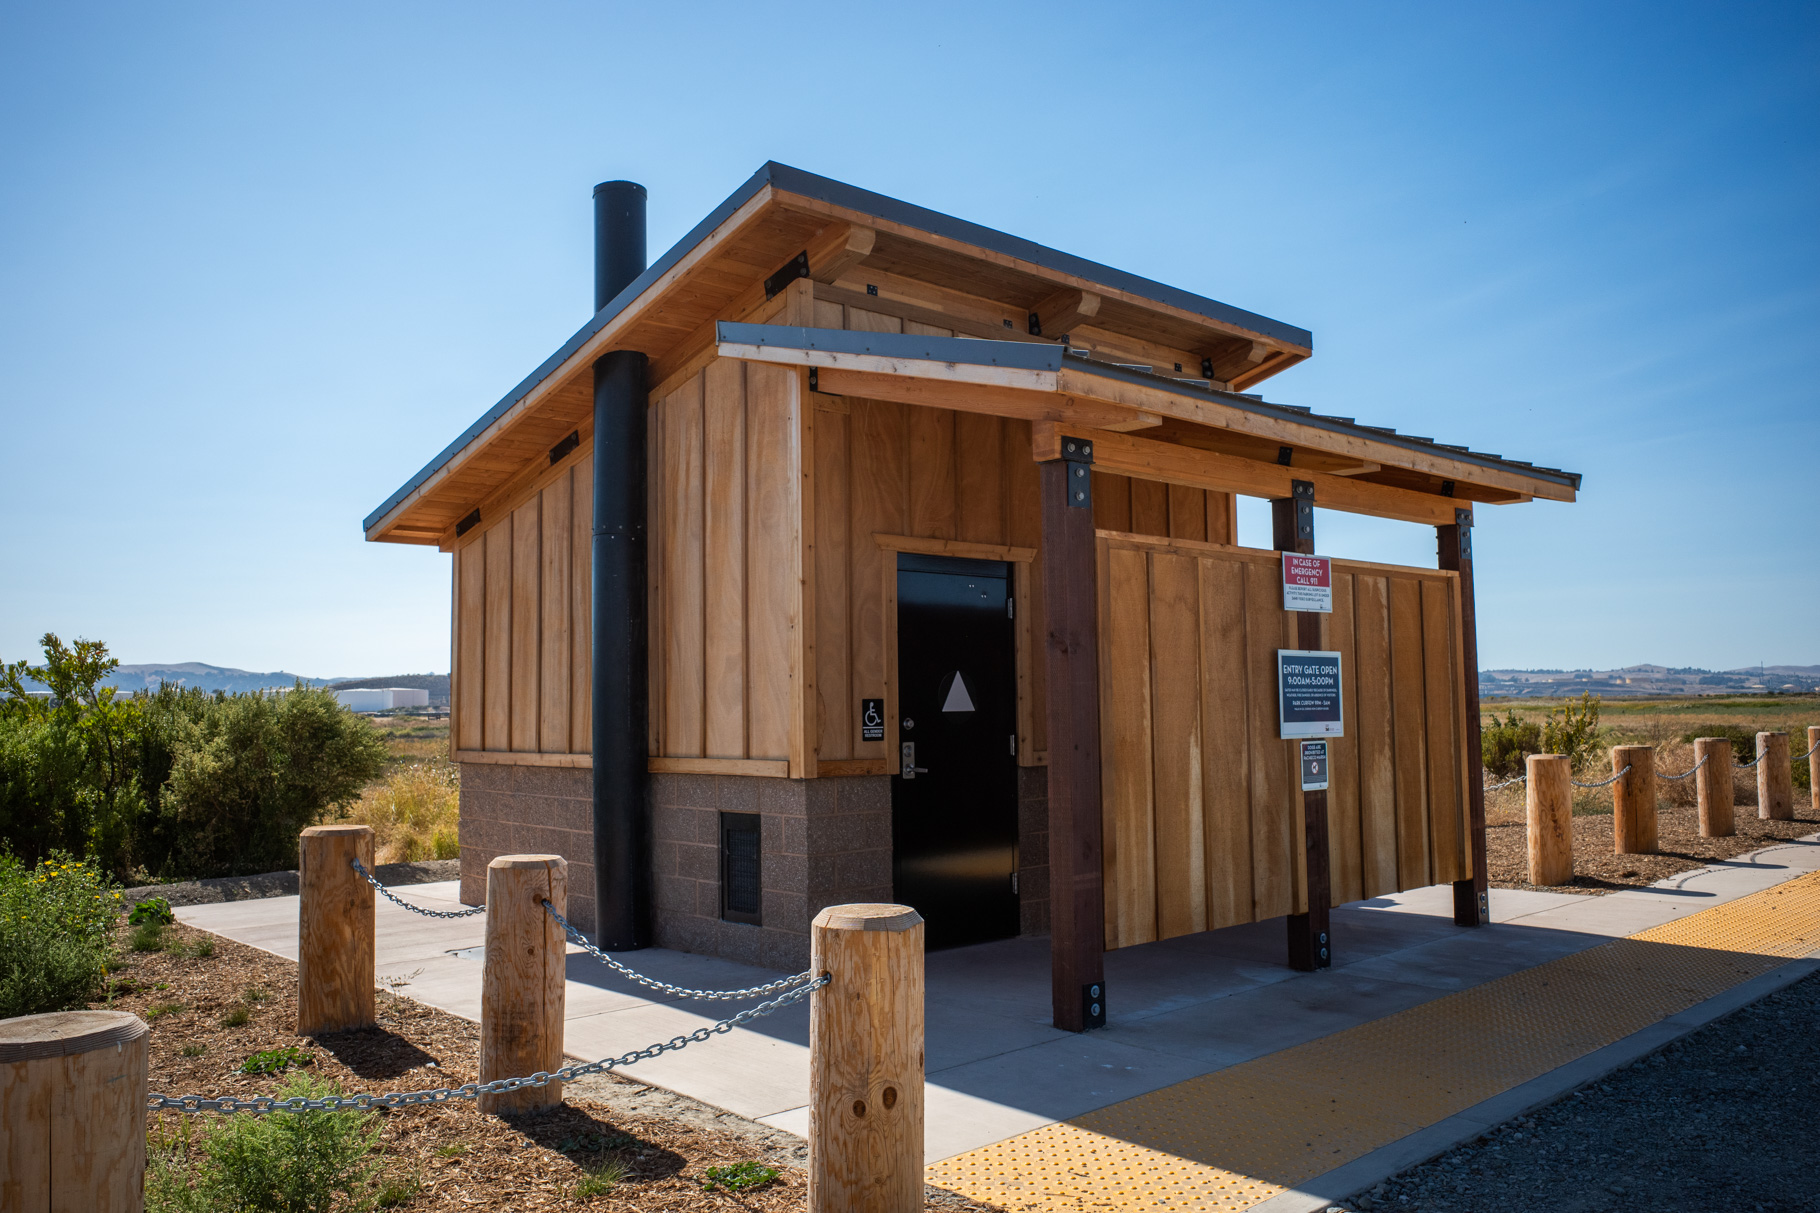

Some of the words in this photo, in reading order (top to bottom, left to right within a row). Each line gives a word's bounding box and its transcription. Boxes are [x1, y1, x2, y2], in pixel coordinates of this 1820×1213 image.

[1291, 567, 1322, 576] EMERGENCY
[1284, 665, 1302, 674] ENTRY
[1304, 665, 1320, 674] GATE
[1321, 666, 1337, 674] OPEN
[1288, 676, 1333, 685] 9:00AM-5:00PM
